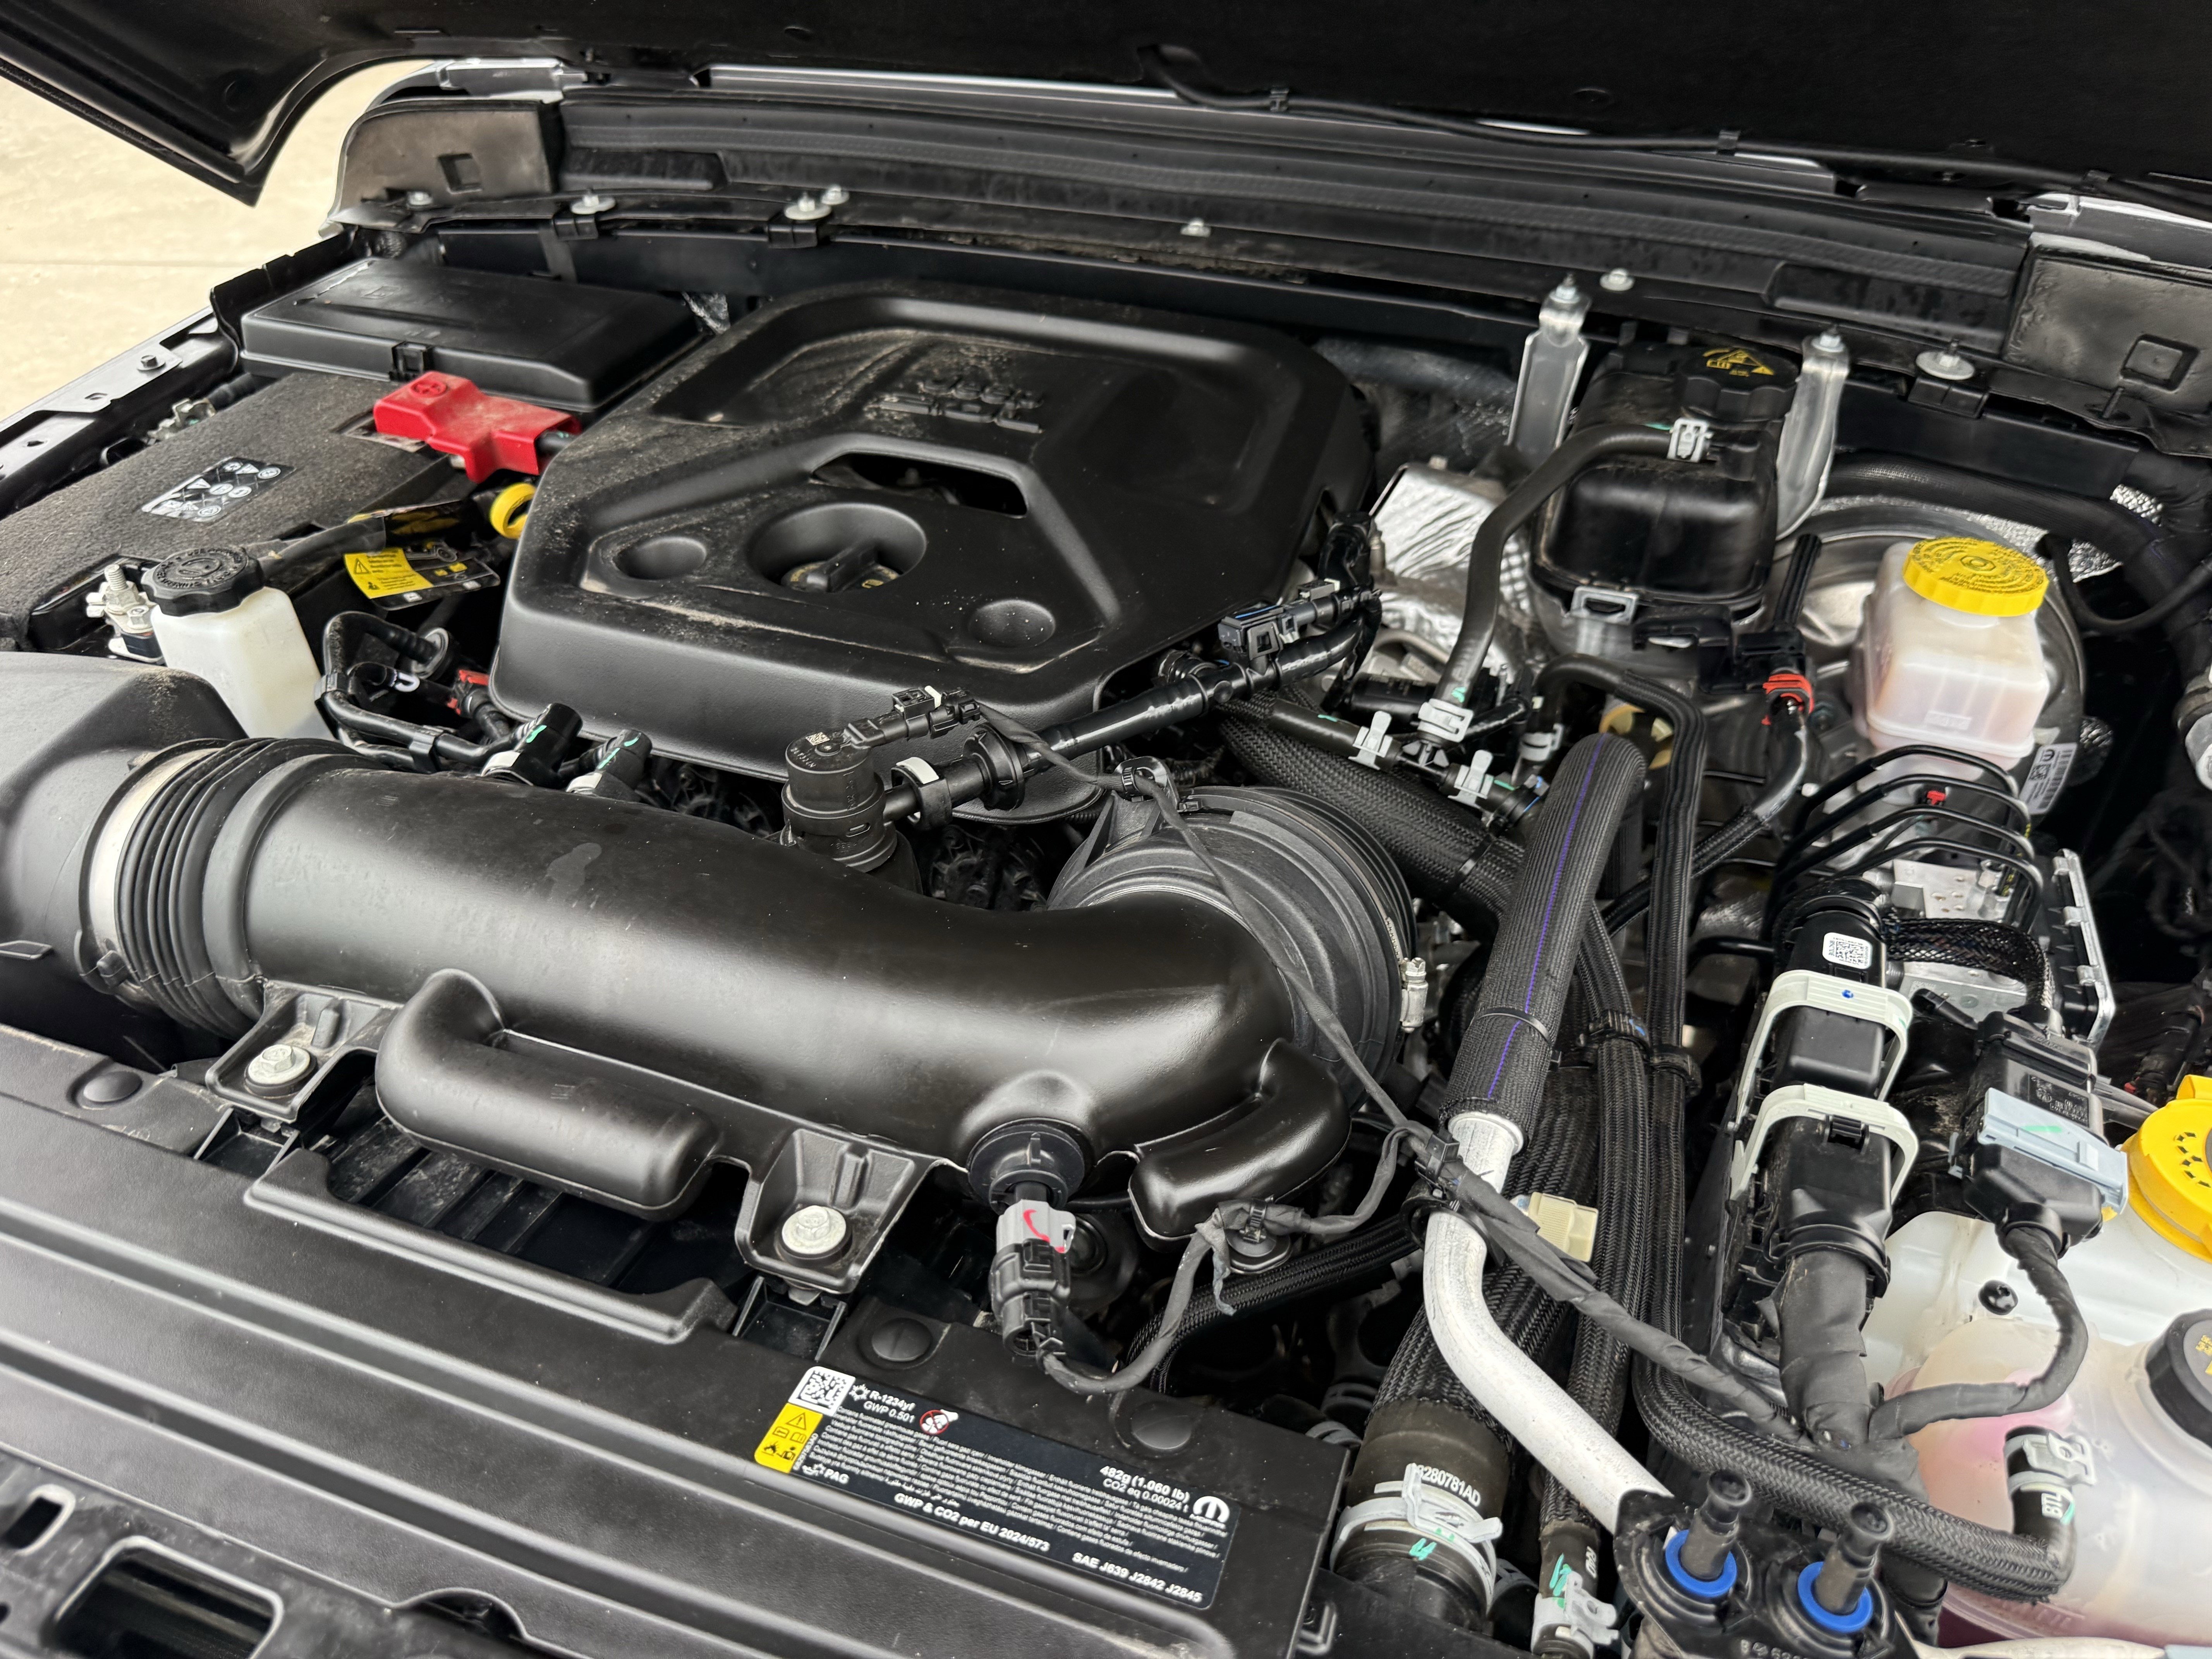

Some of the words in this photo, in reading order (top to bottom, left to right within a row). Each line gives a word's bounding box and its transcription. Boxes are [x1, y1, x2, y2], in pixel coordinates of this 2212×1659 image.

[863, 1400, 889, 1414] GWP
[888, 1408, 915, 1423] 0.501
[869, 1390, 915, 1411] R-1234yf
[823, 1468, 849, 1484] PAG
[1099, 1465, 1132, 1485] 482g
[1131, 1475, 1171, 1498] (1.060
[1171, 1487, 1190, 1504] lb)
[1102, 1478, 1127, 1493] CO2
[1126, 1487, 1141, 1499] eq
[1141, 1490, 1183, 1510] 0.00024
[893, 1492, 924, 1508] GWP
[922, 1502, 933, 1513] &
[933, 1506, 960, 1522] CO2
[958, 1516, 981, 1528] per
[979, 1521, 1000, 1535] EU
[998, 1527, 1050, 1552] 2024/573
[1072, 1552, 1100, 1569] SAE
[1098, 1562, 1129, 1578] J639
[1128, 1571, 1166, 1591] J2842
[1164, 1583, 1203, 1603] J2845
